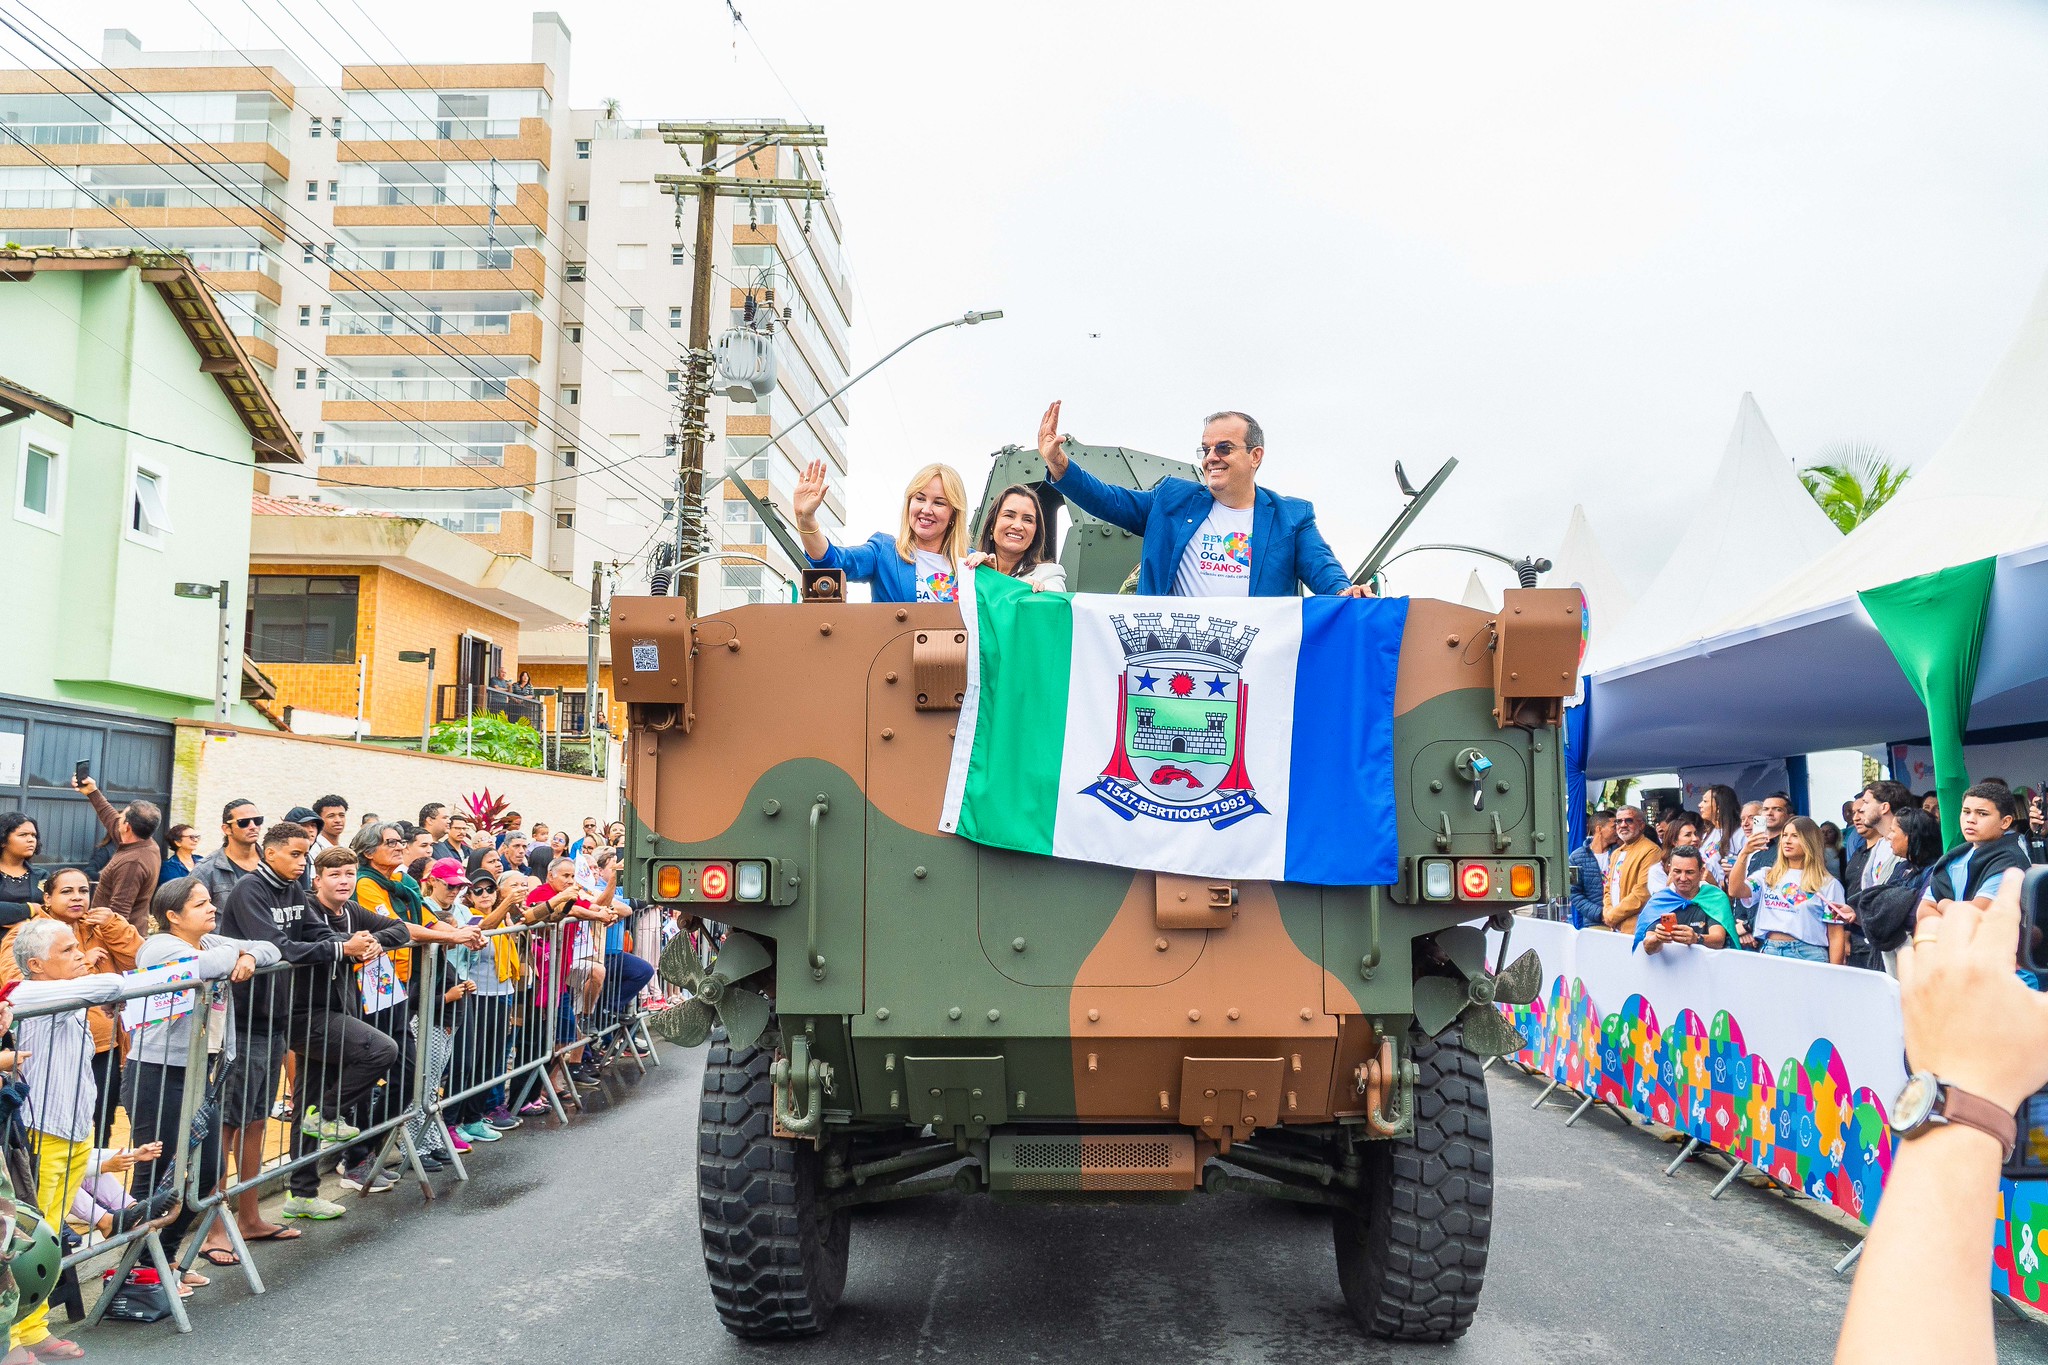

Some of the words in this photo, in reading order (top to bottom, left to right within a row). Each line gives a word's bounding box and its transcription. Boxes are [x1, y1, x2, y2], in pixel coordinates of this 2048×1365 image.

[1203, 534, 1222, 543] BER
[1202, 542, 1213, 551] TI
[1201, 551, 1225, 561] OGA
[1200, 561, 1212, 570] 35
[1213, 563, 1242, 573] ANOS
[916, 591, 930, 600] GA
[1106, 781, 1246, 819] 1547-BERTIOGA-1993
